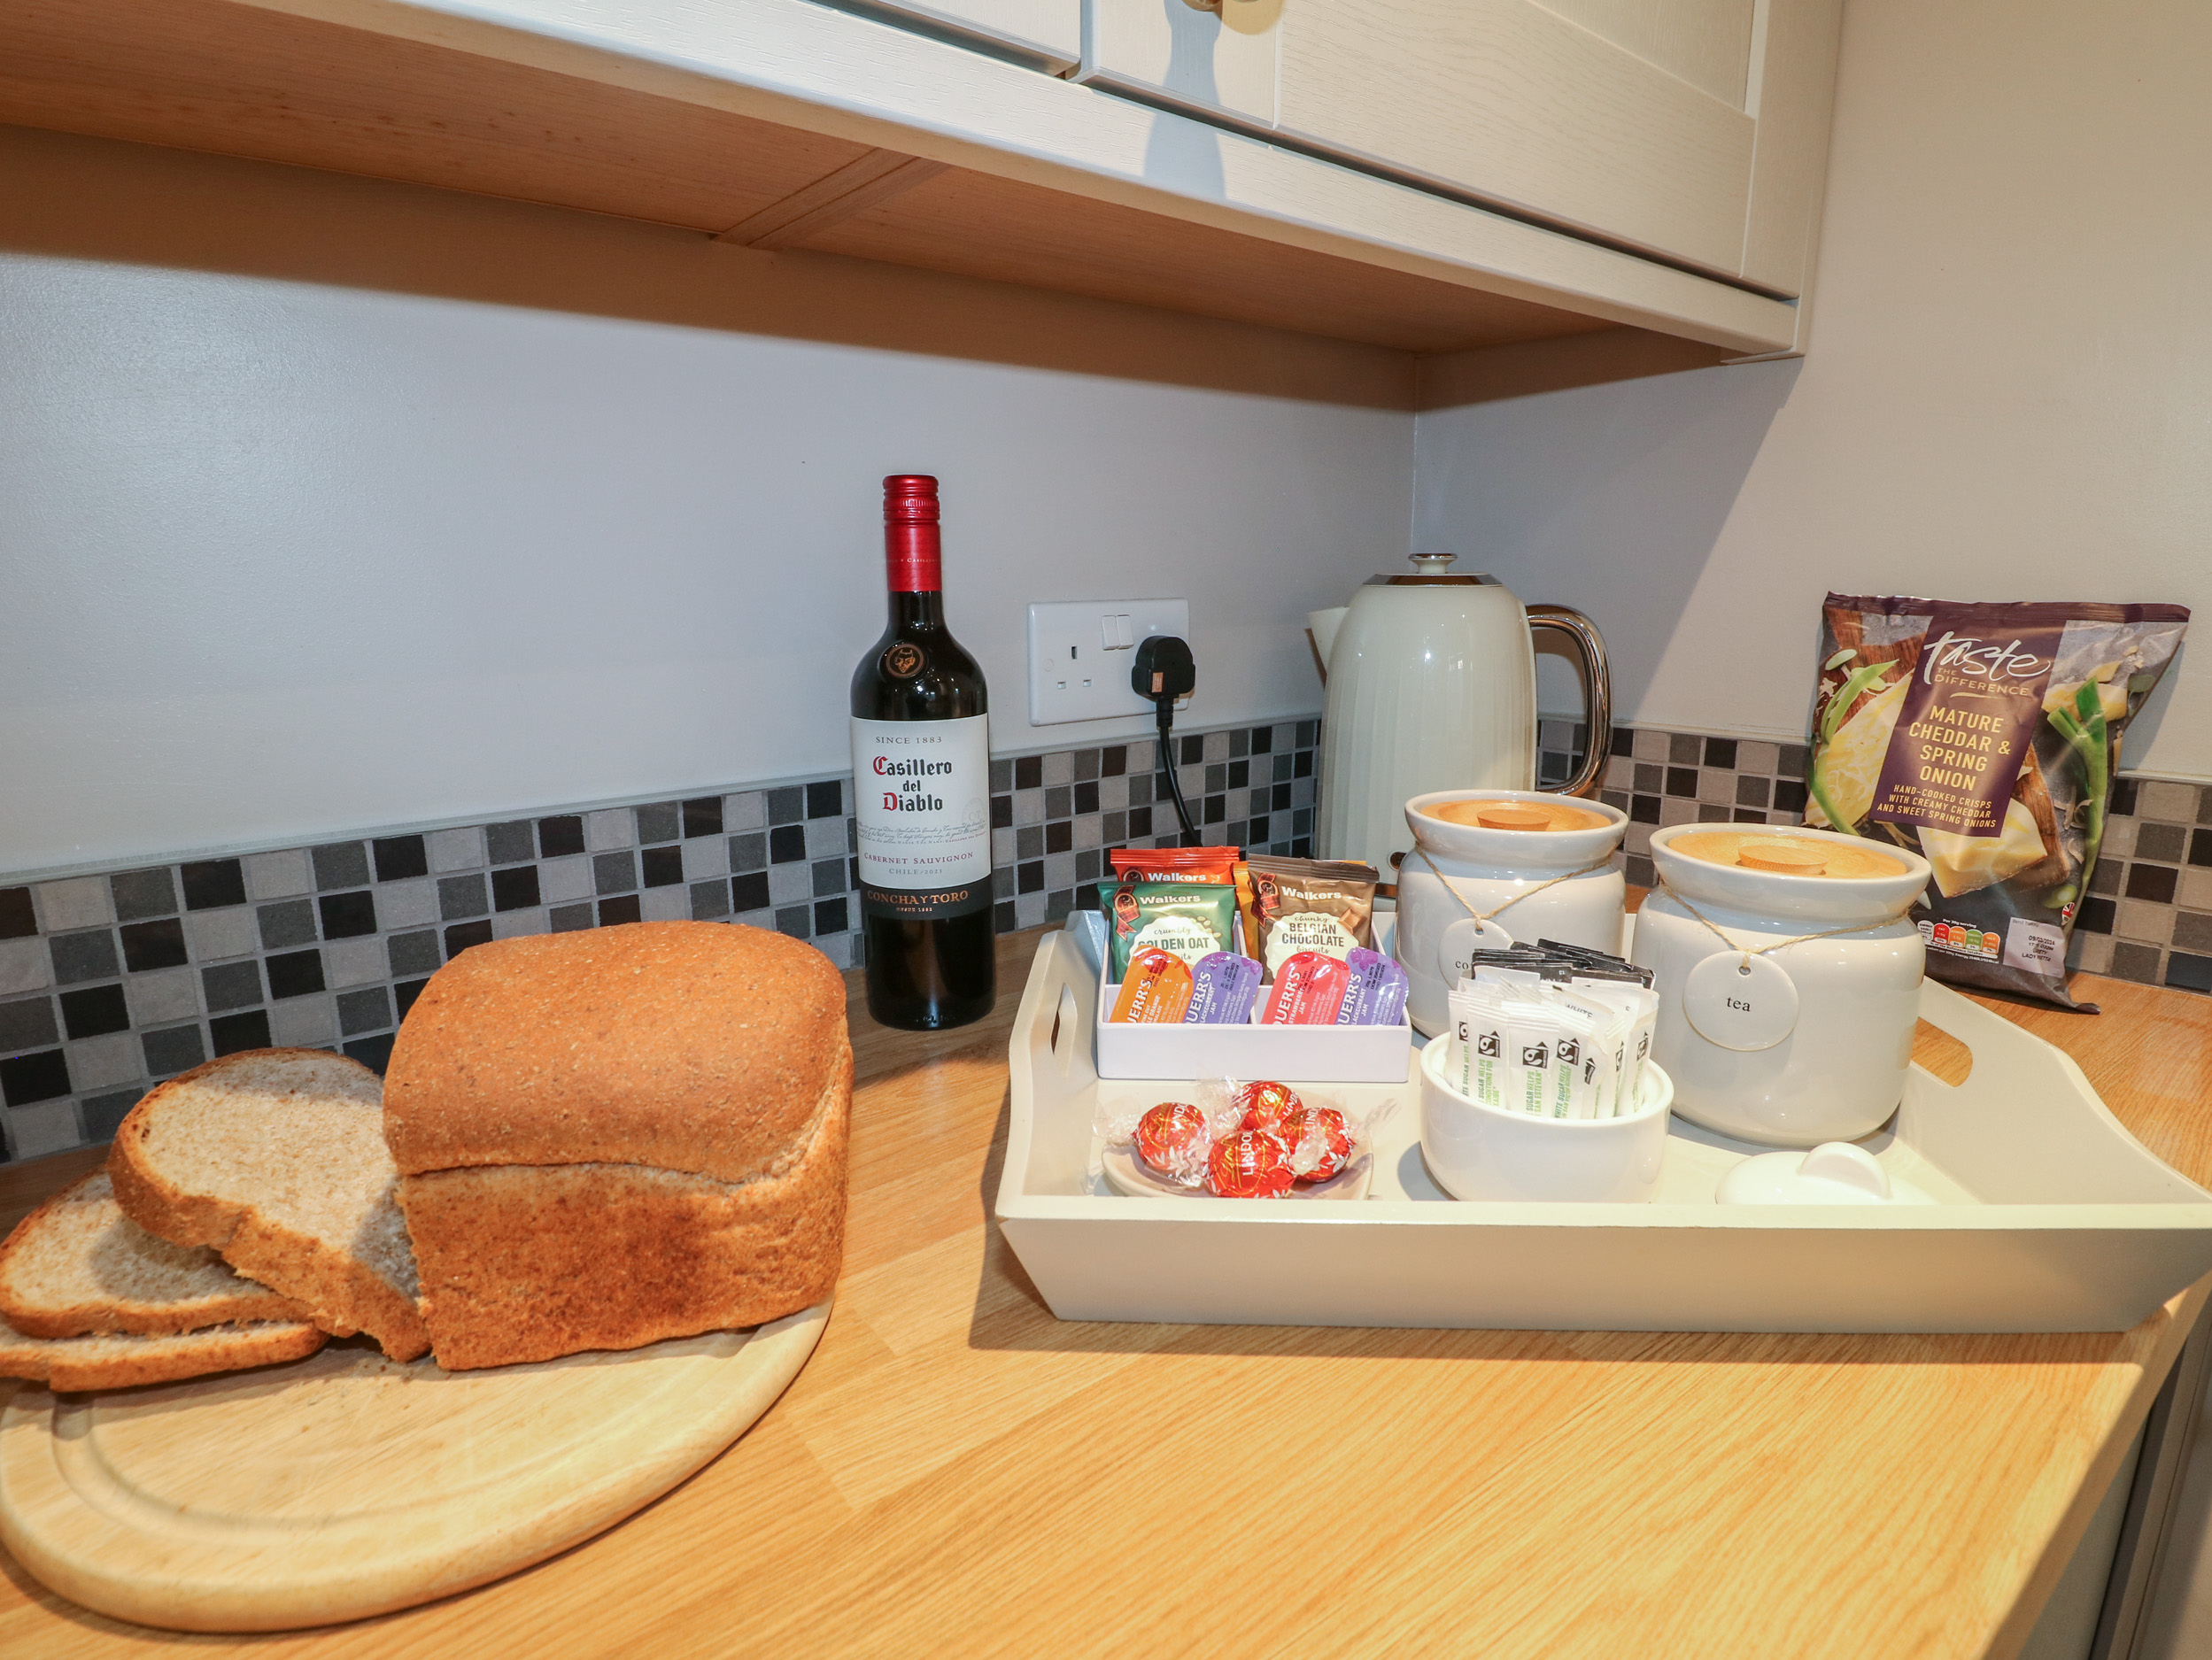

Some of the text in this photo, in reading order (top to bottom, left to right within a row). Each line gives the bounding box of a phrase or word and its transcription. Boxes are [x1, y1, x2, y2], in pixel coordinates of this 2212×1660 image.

[1934, 674, 2030, 696] DIFFERENCE
[1930, 705, 2004, 733] MATURE
[1908, 722, 2011, 755] CHEDDAR &
[873, 755, 953, 776] Casillero
[1920, 745, 1988, 771] SPRING
[903, 780, 921, 791] del
[1920, 766, 1976, 791] ONION
[883, 792, 943, 811] Diablo
[1889, 794, 1992, 818] WITH CREAMY CHEDDAR
[1893, 784, 1992, 809] HAND-COOKED CRISPS
[1877, 803, 1997, 828] AND SWEET SPRING ONIONS
[864, 852, 973, 864] CABERNET SAUVIGNON
[1148, 872, 1206, 882] Walkers
[867, 890, 918, 905] CONCHA
[930, 890, 969, 904] TORO
[1139, 895, 1201, 905] Walkers
[1280, 885, 1342, 900] Walkers
[1289, 923, 1336, 934] BELGIAN
[1187, 937, 1210, 948] OAT
[1282, 933, 1344, 947] CHOCOLATE
[1455, 961, 1470, 970] co
[1186, 970, 1211, 1022] UERR'S
[1200, 985, 1215, 1023] LACKCURRANT
[1288, 988, 1303, 1023] STRAWBERRY
[1338, 973, 1362, 1023] UERR'S
[1351, 987, 1366, 1024] LACKCURRANT
[1727, 997, 1751, 1012] tea
[1209, 1001, 1218, 1015] JAM
